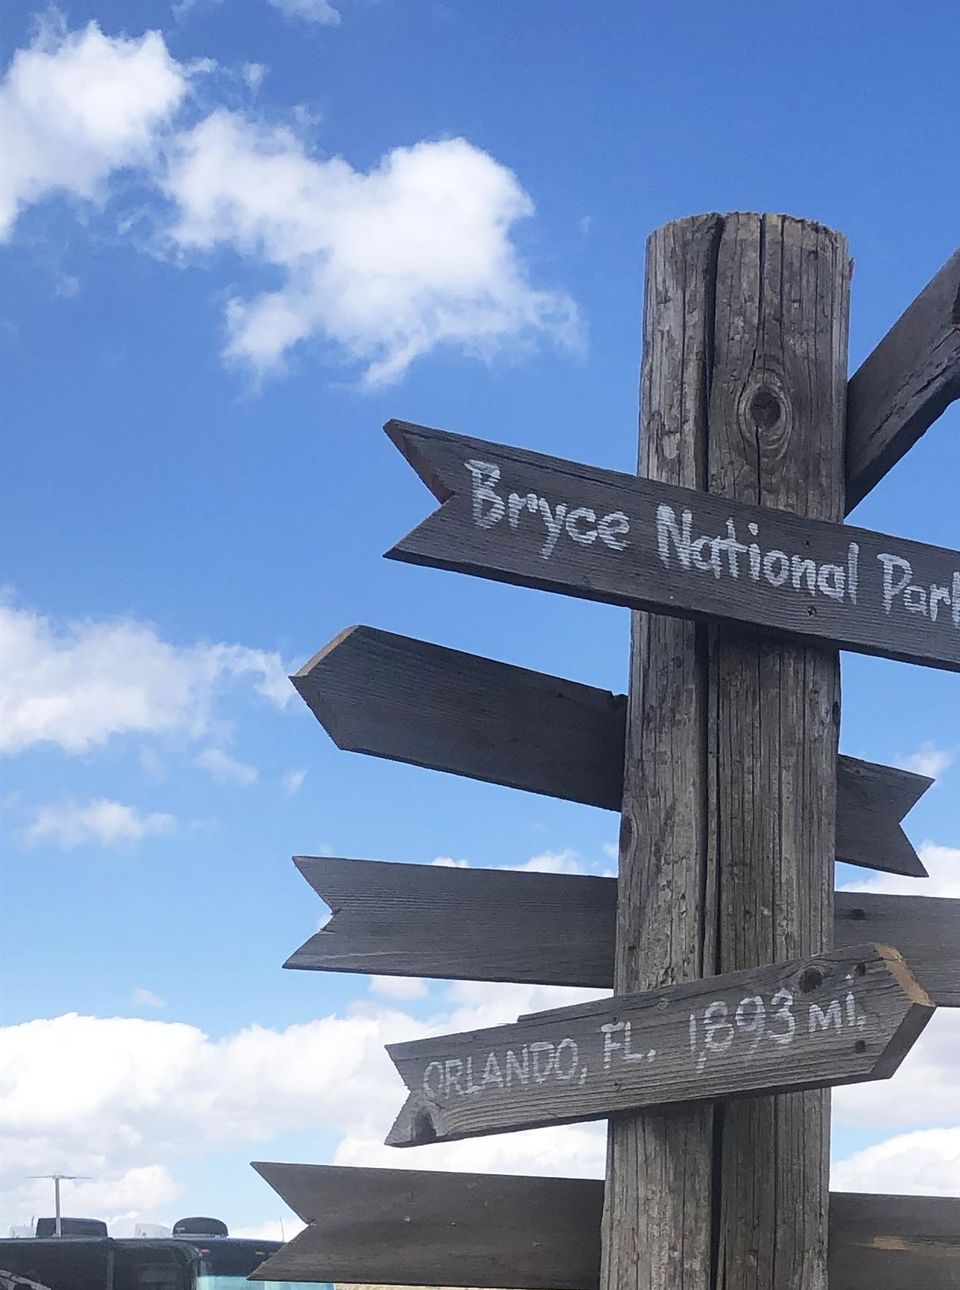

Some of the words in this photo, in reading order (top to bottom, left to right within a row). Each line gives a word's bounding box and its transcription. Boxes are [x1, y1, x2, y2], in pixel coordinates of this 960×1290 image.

[463, 458, 630, 560] Bryce
[655, 502, 860, 606] National
[422, 1037, 588, 1102] ORLANDO,
